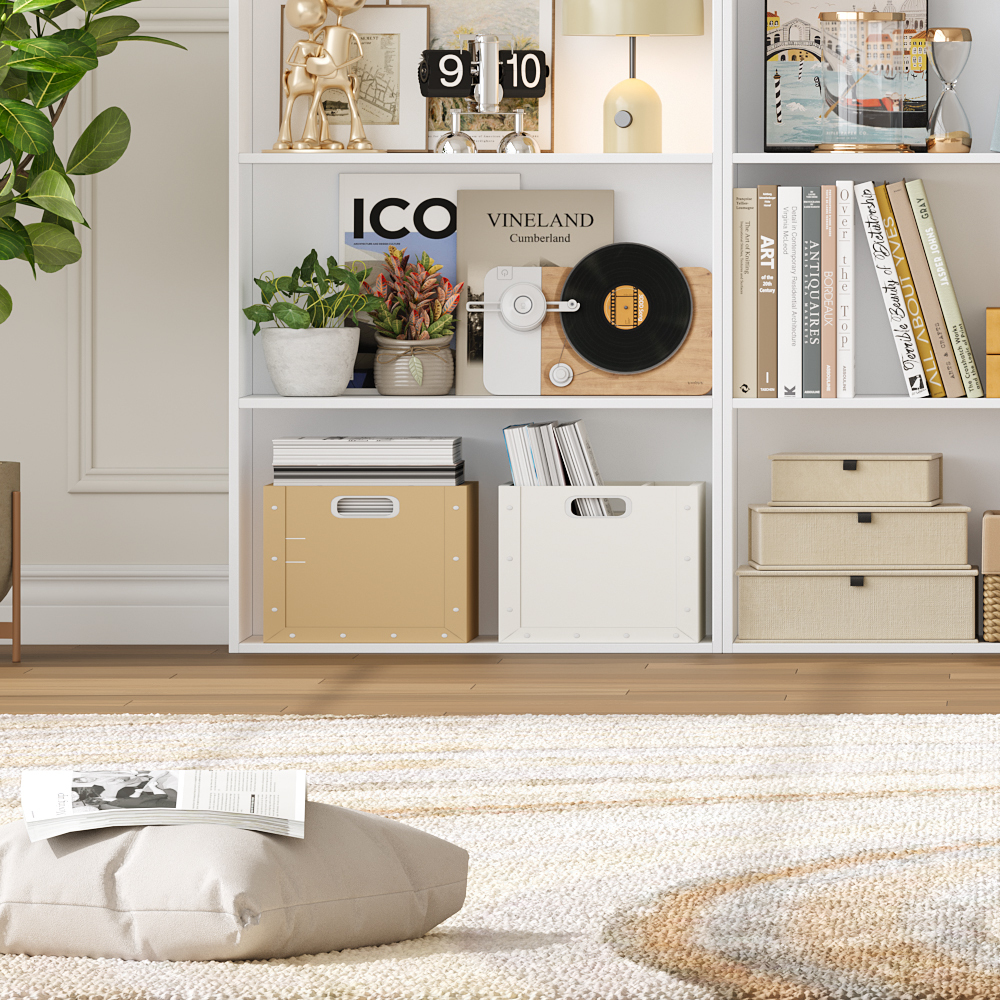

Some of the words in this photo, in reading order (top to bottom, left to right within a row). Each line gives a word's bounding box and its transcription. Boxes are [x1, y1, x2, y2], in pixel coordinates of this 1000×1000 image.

[439, 54, 464, 87] 9
[507, 53, 541, 89] 10
[487, 213, 594, 228] VINELAND
[861, 188, 890, 260] Dictatorship
[916, 198, 928, 219] GRAY
[509, 233, 571, 243] Cumberland
[761, 235, 774, 269] ART
[884, 216, 904, 266] YVES
[925, 226, 939, 252] JOHNS
[876, 265, 892, 275] of
[934, 253, 949, 286] JASPER
[809, 240, 819, 344] ANTIQUAIRES
[824, 271, 833, 326] BORDEAUX
[882, 280, 905, 321] Beauty
[899, 276, 929, 344] ABOUT
[895, 323, 917, 371] Terrible
[922, 355, 941, 387] ALL
